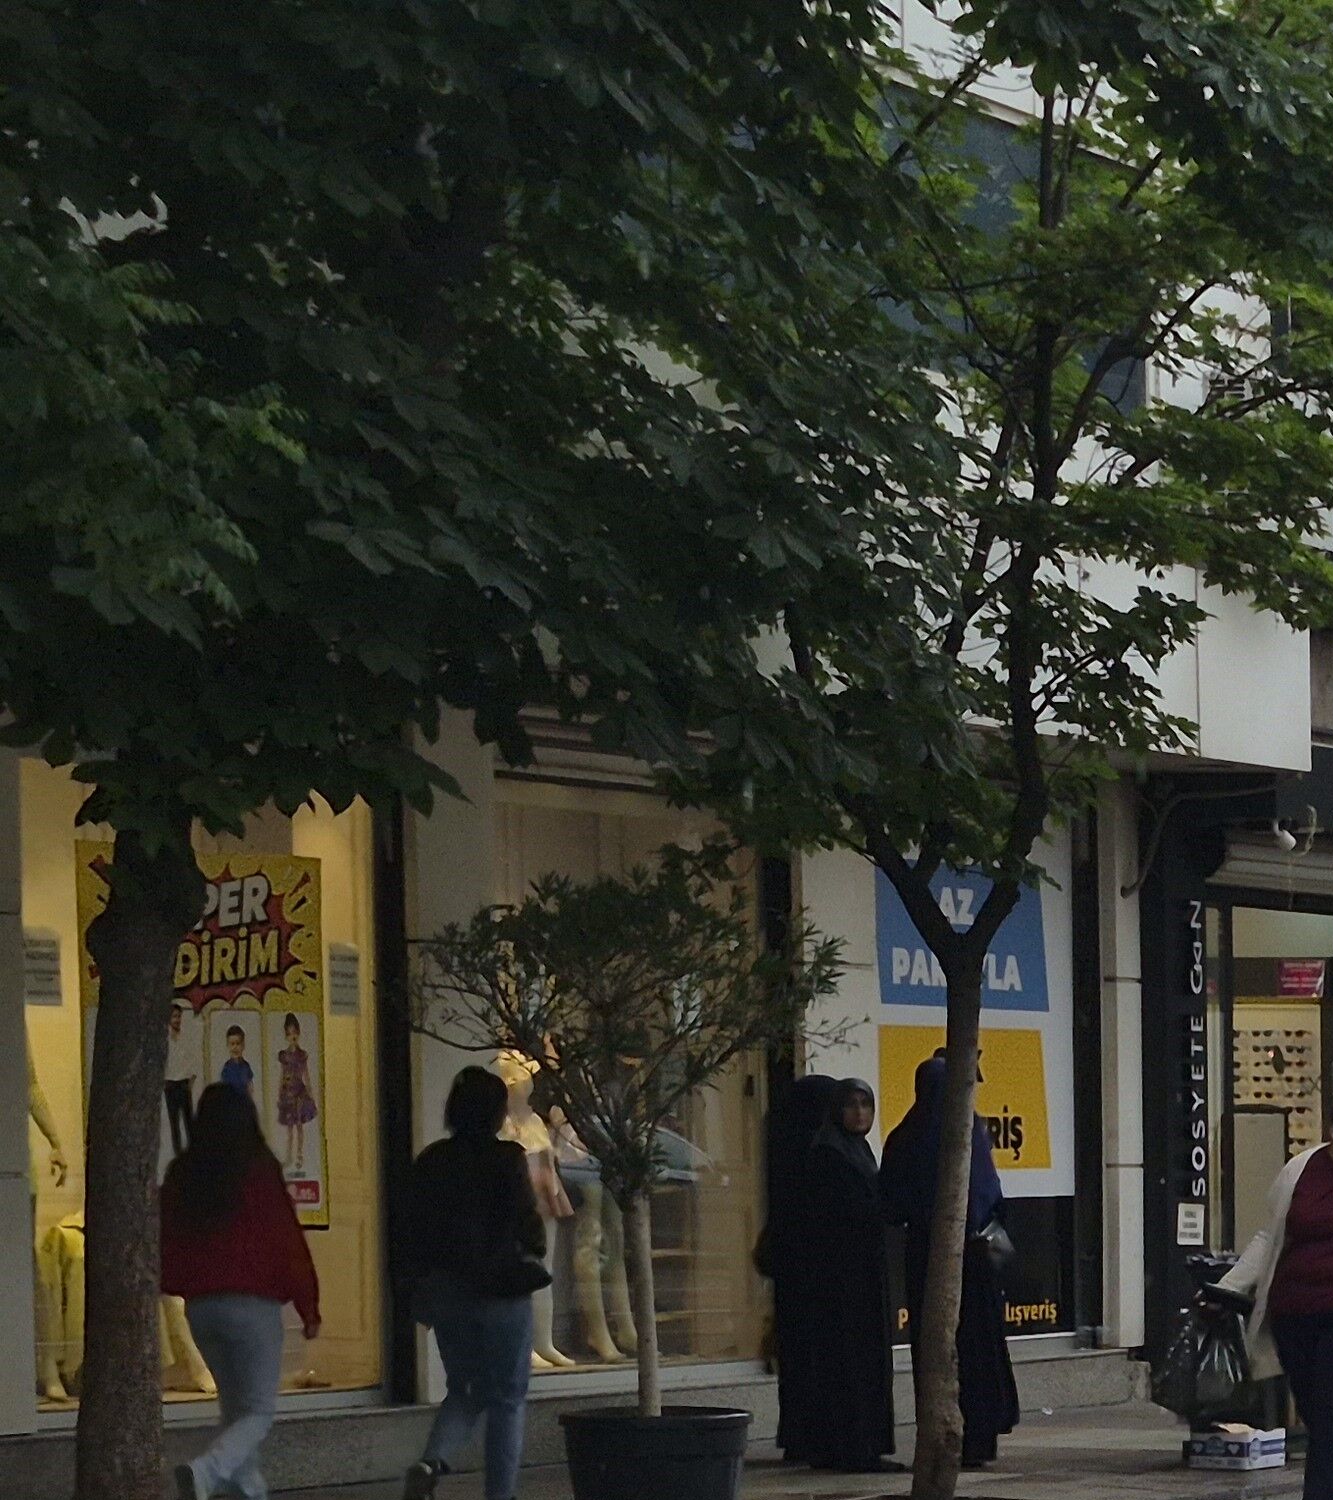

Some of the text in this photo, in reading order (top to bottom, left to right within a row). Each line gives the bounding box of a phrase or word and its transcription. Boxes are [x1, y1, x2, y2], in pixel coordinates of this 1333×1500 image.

[938, 887, 975, 926] AZ
[174, 927, 280, 988] DİRİM
[1190, 1014, 1206, 1198] SOSYETE
